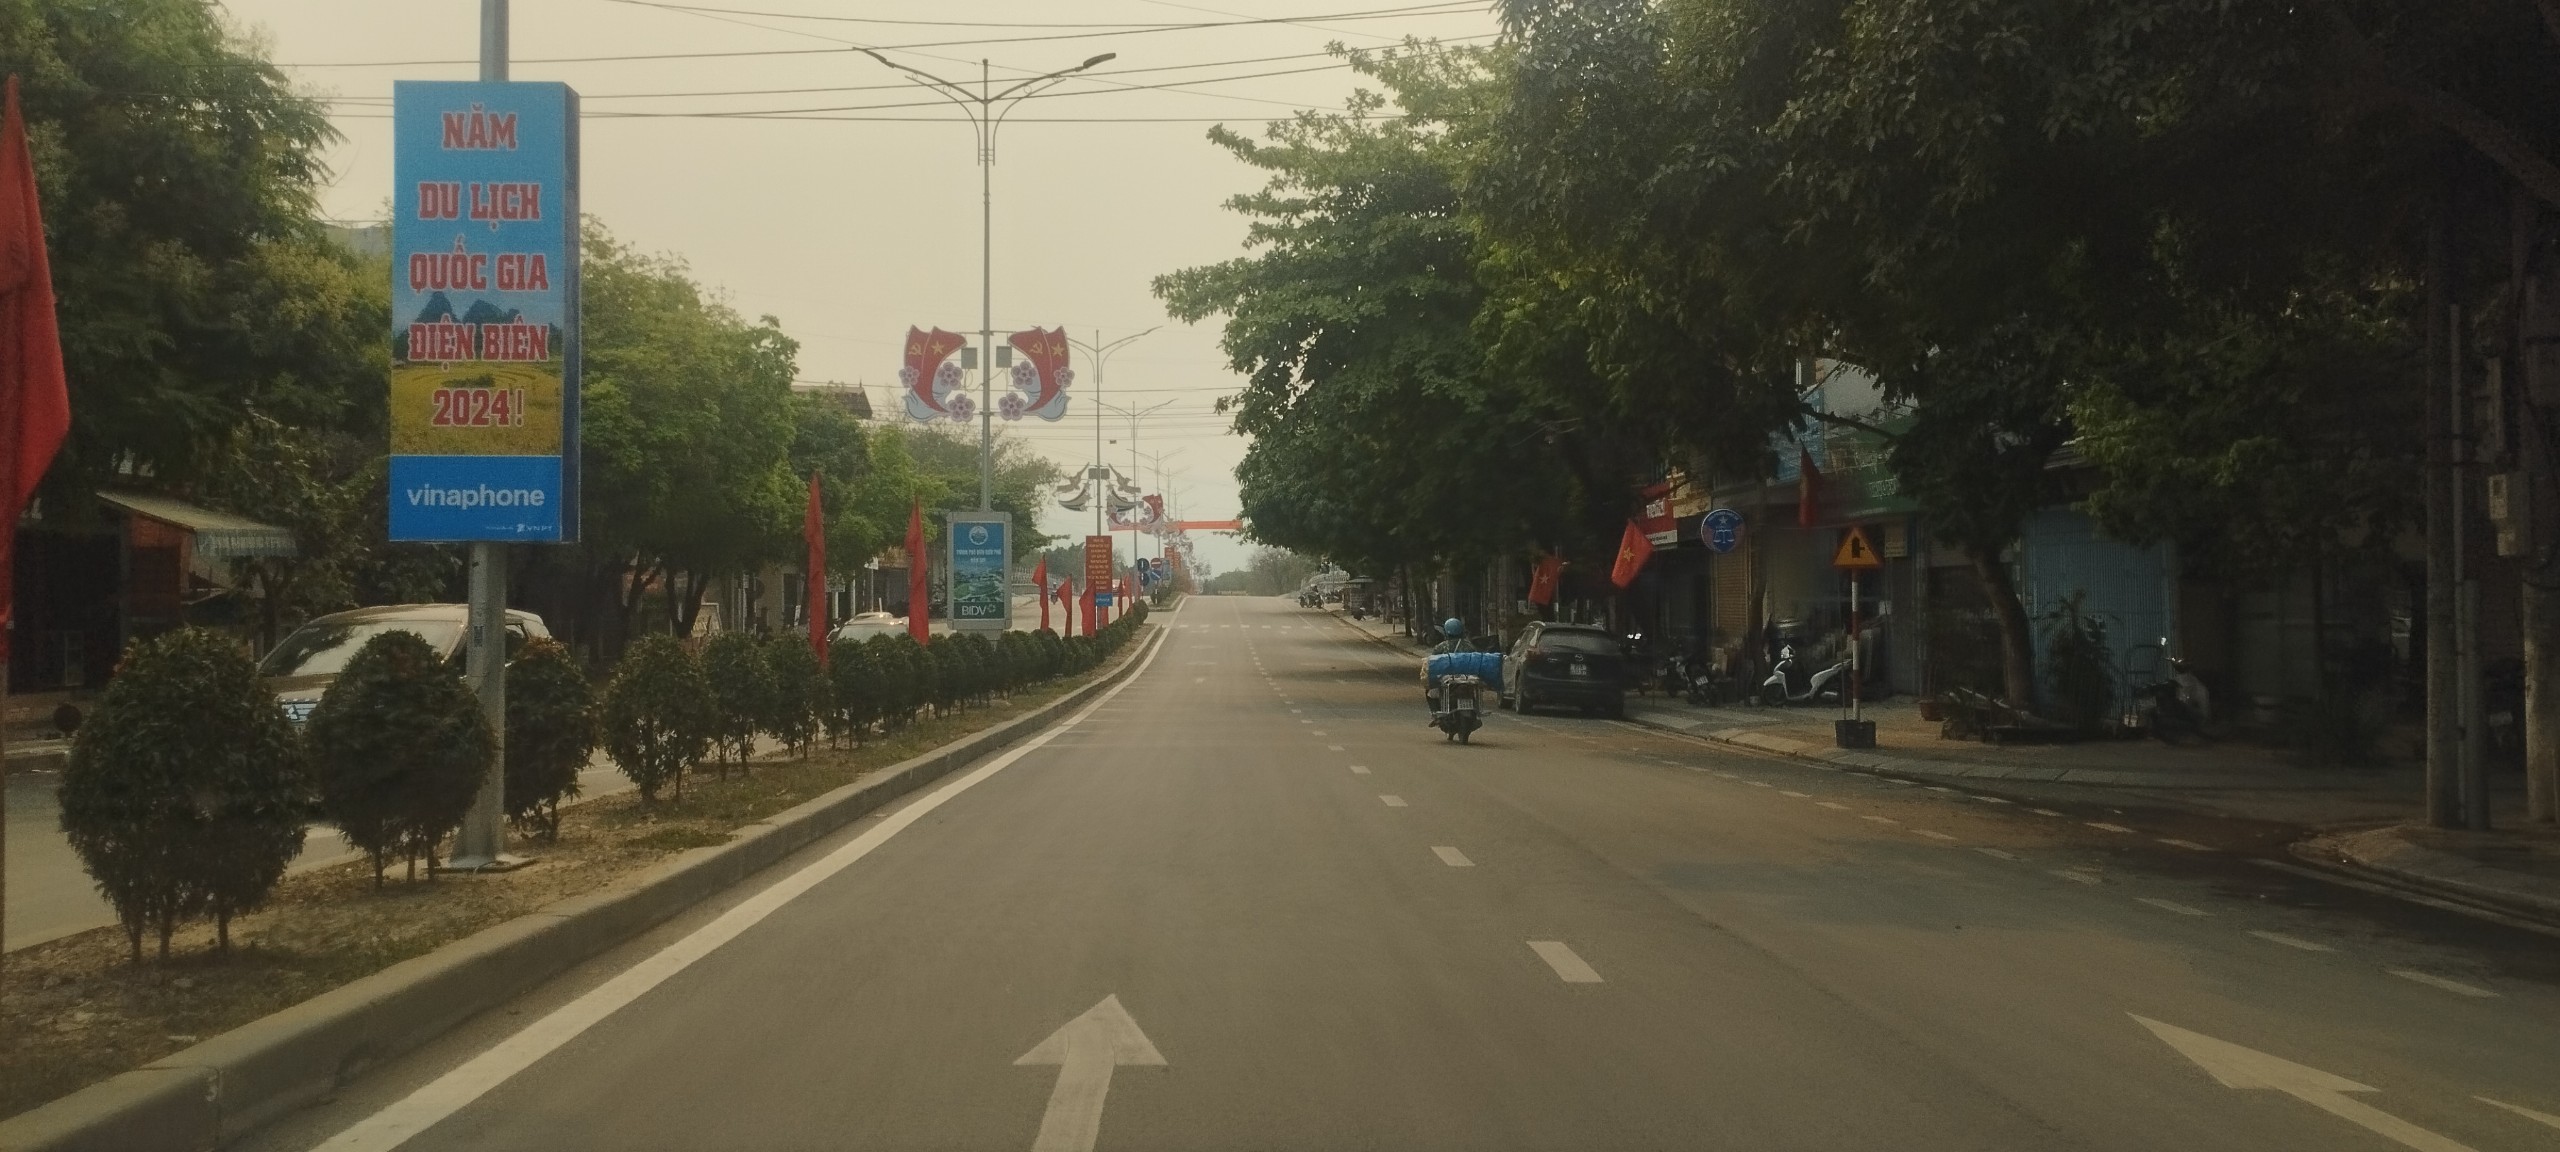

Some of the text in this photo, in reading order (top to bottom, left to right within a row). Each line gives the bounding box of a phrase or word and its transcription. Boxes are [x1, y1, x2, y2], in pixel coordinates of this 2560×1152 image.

[441, 103, 518, 150] NĂM
[418, 181, 541, 231] DU LỊCH
[409, 233, 549, 293] QUỐC GIA
[408, 313, 549, 372] ĐIỆN BIÊN
[407, 483, 545, 510] vinaphone
[961, 605, 987, 616] BIDV
